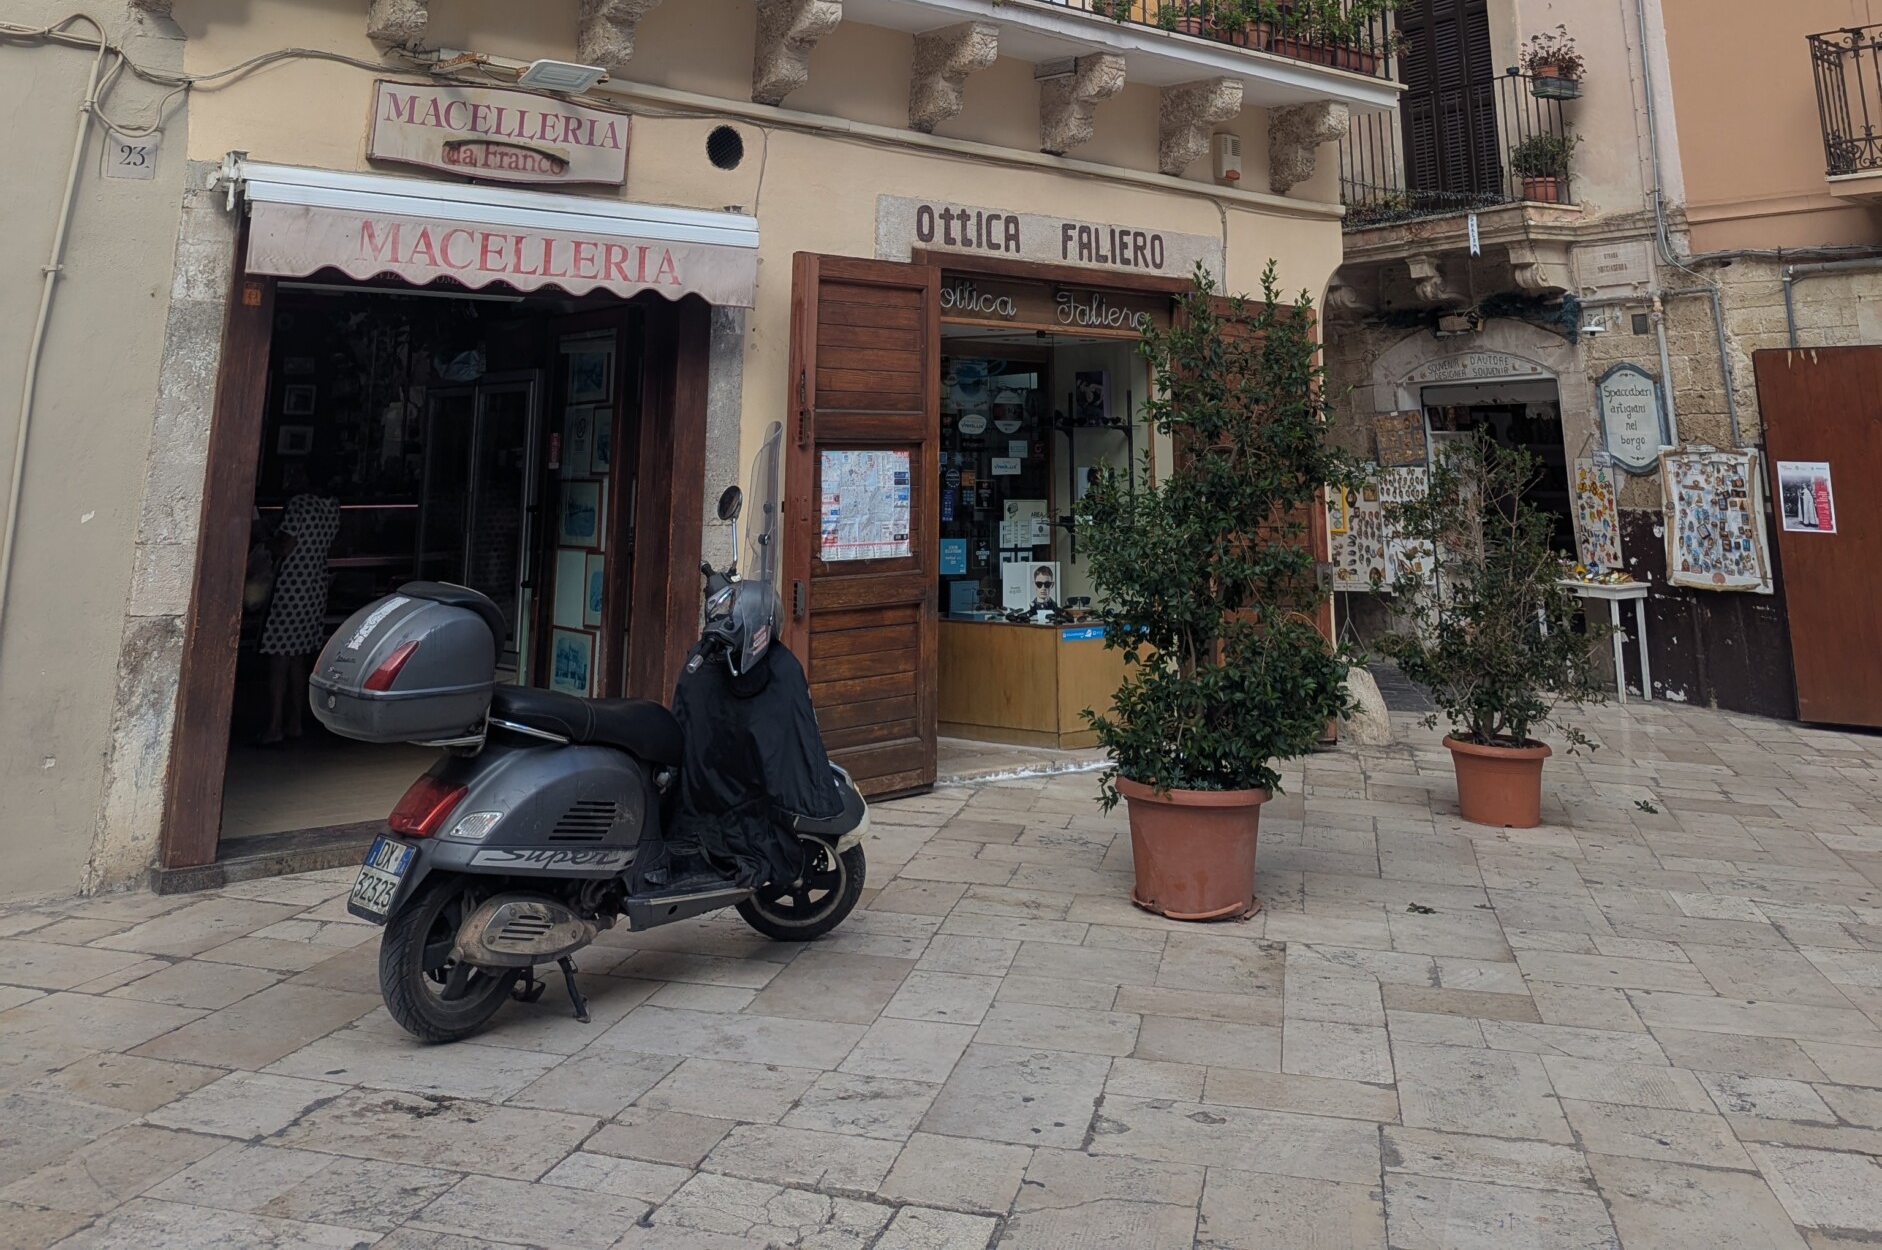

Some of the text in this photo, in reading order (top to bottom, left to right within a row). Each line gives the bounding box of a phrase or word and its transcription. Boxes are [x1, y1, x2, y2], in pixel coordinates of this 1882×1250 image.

[383, 91, 621, 151] MACELLERIA
[446, 143, 564, 175] da Franco
[354, 219, 684, 287] MACELLERIA
[1061, 222, 1164, 270] FALIERO
[1427, 355, 1509, 375] SOUVENIR D'AUTORE
[1434, 366, 1509, 381] DESIGNER SOUVENIR
[1603, 385, 1652, 404] Spaccabari
[1610, 402, 1646, 420] artigiani
[1625, 420, 1638, 432] nel
[1620, 435, 1646, 452] borgo
[375, 841, 398, 870] DX
[353, 871, 397, 908] 32323
